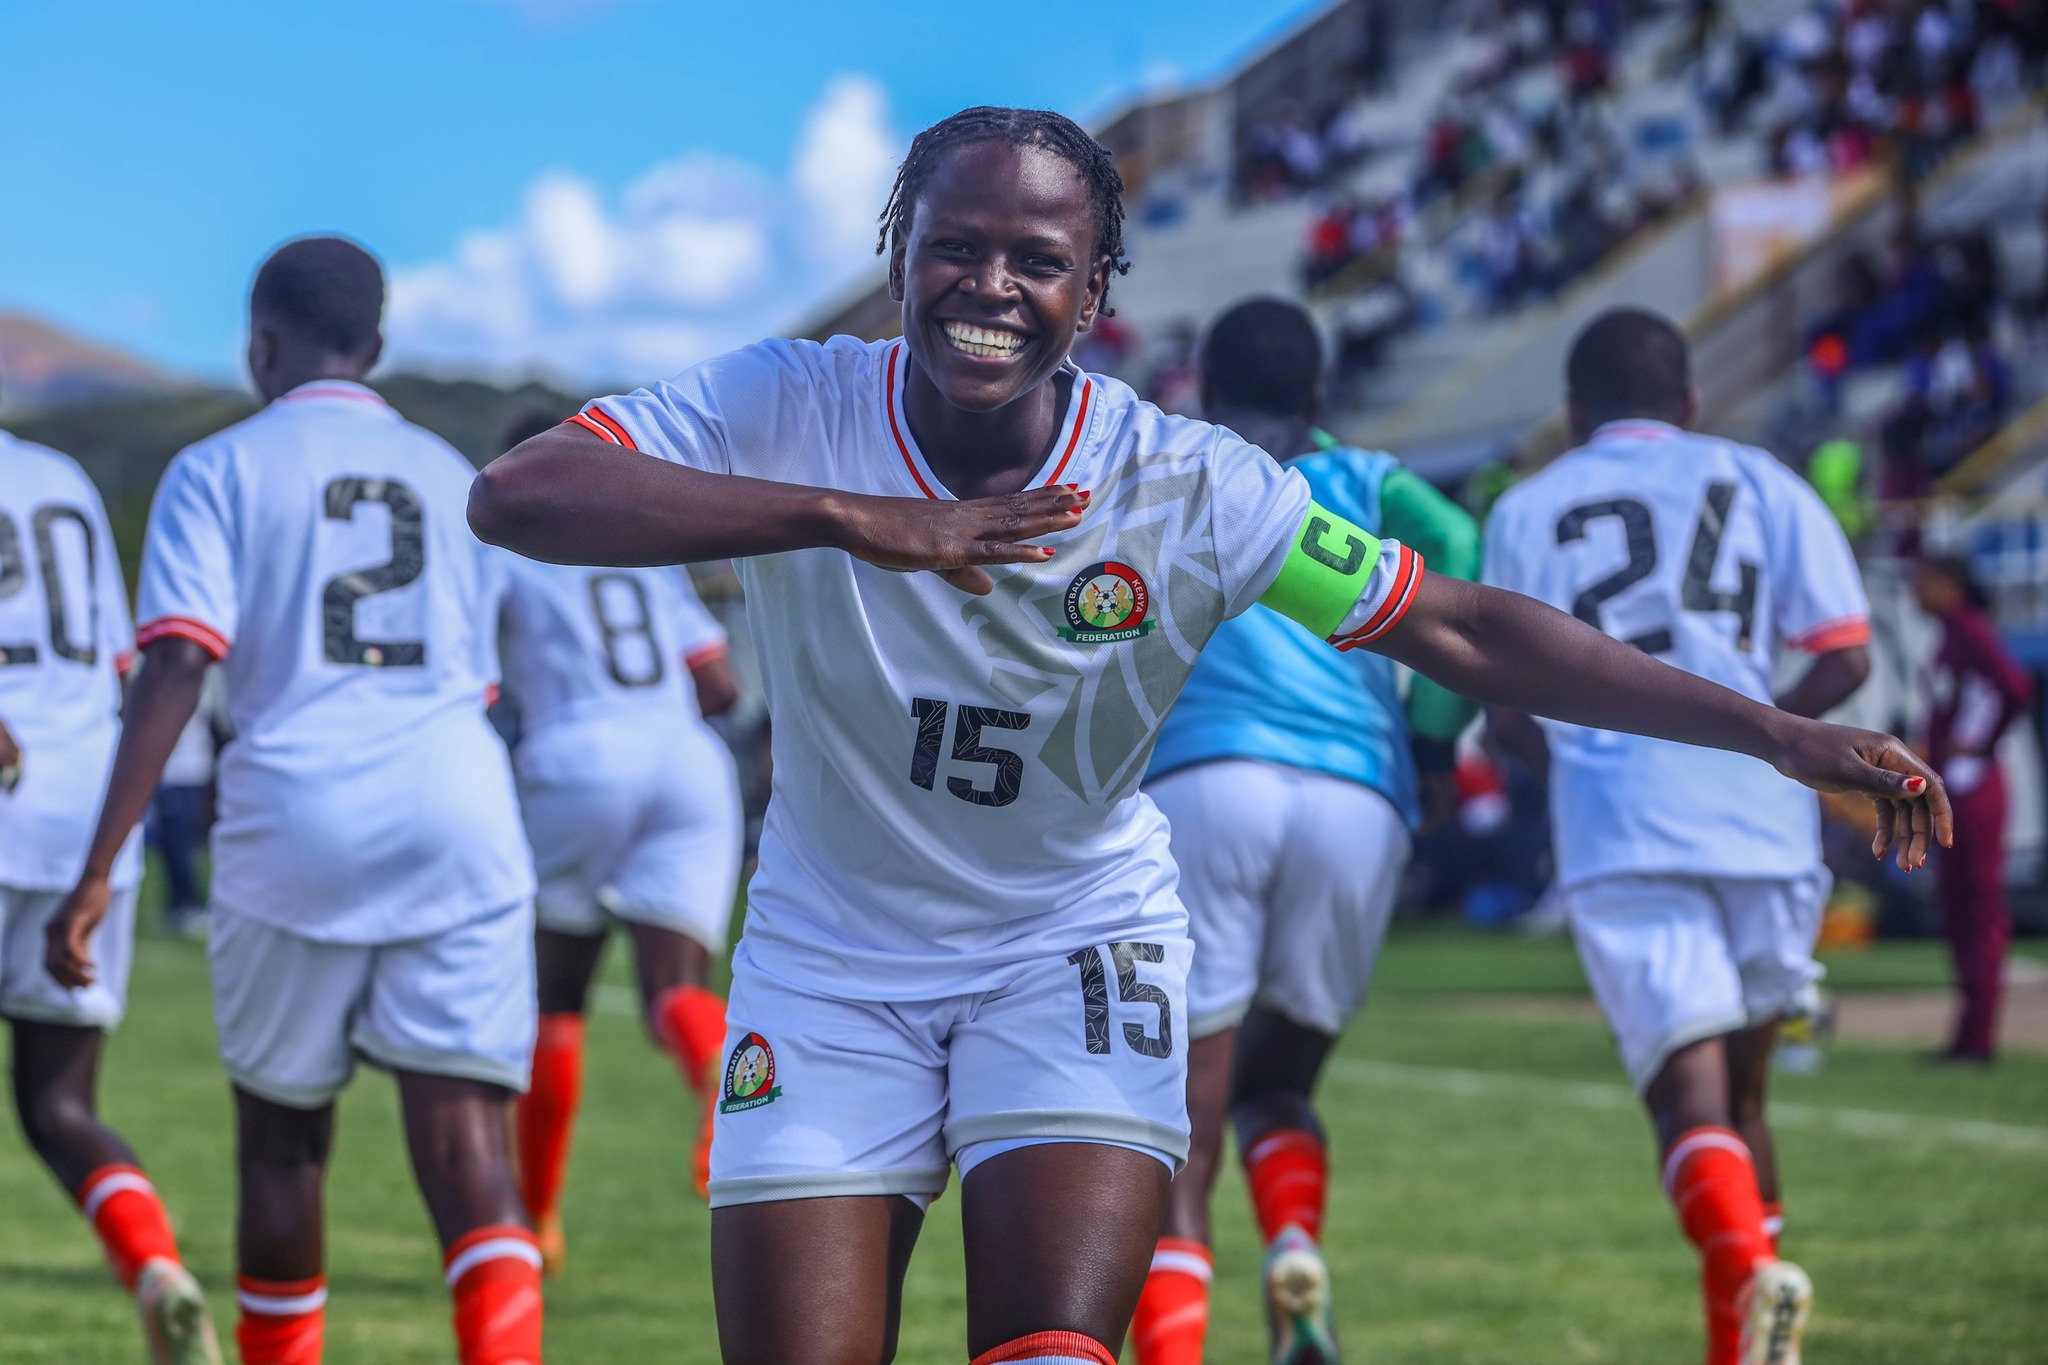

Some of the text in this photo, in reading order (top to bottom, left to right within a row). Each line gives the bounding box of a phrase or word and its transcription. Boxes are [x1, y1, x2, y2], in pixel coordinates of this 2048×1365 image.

[323, 477, 425, 667] 2
[1300, 516, 1367, 576] C
[1556, 484, 1758, 652] 24
[1068, 576, 1086, 625] FOOTBALL
[1132, 579, 1144, 612] KENYA
[588, 572, 664, 688] 8
[1076, 629, 1140, 641] FEDERATION
[910, 697, 1031, 807] 15
[1067, 942, 1172, 1059] 15
[727, 1049, 743, 1097] FOOTBALL
[725, 1096, 768, 1112] FEDERATION
